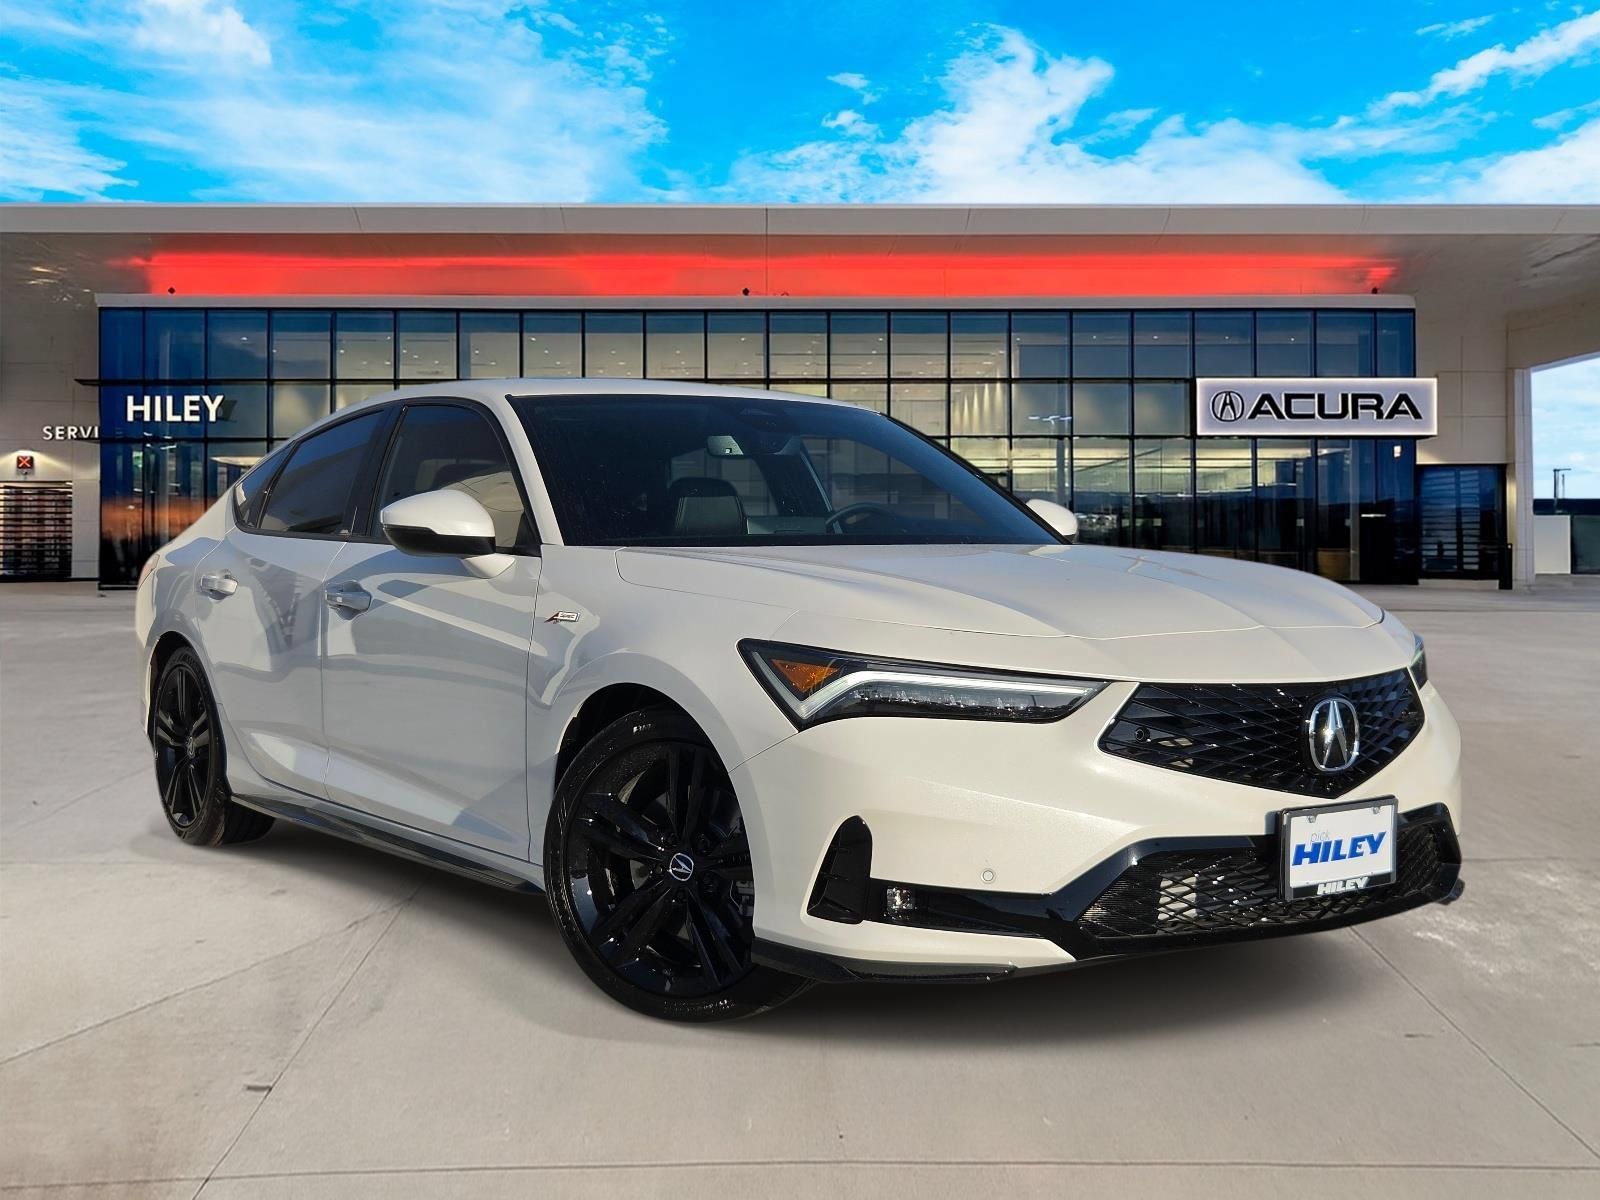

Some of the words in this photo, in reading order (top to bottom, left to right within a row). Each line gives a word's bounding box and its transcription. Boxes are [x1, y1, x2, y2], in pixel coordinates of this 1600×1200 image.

[126, 395, 224, 422] HILEY
[1247, 393, 1422, 420] ACURA
[42, 425, 99, 440] SERVI
[1292, 831, 1386, 866] HILEY
[1316, 876, 1369, 895] HILEY
